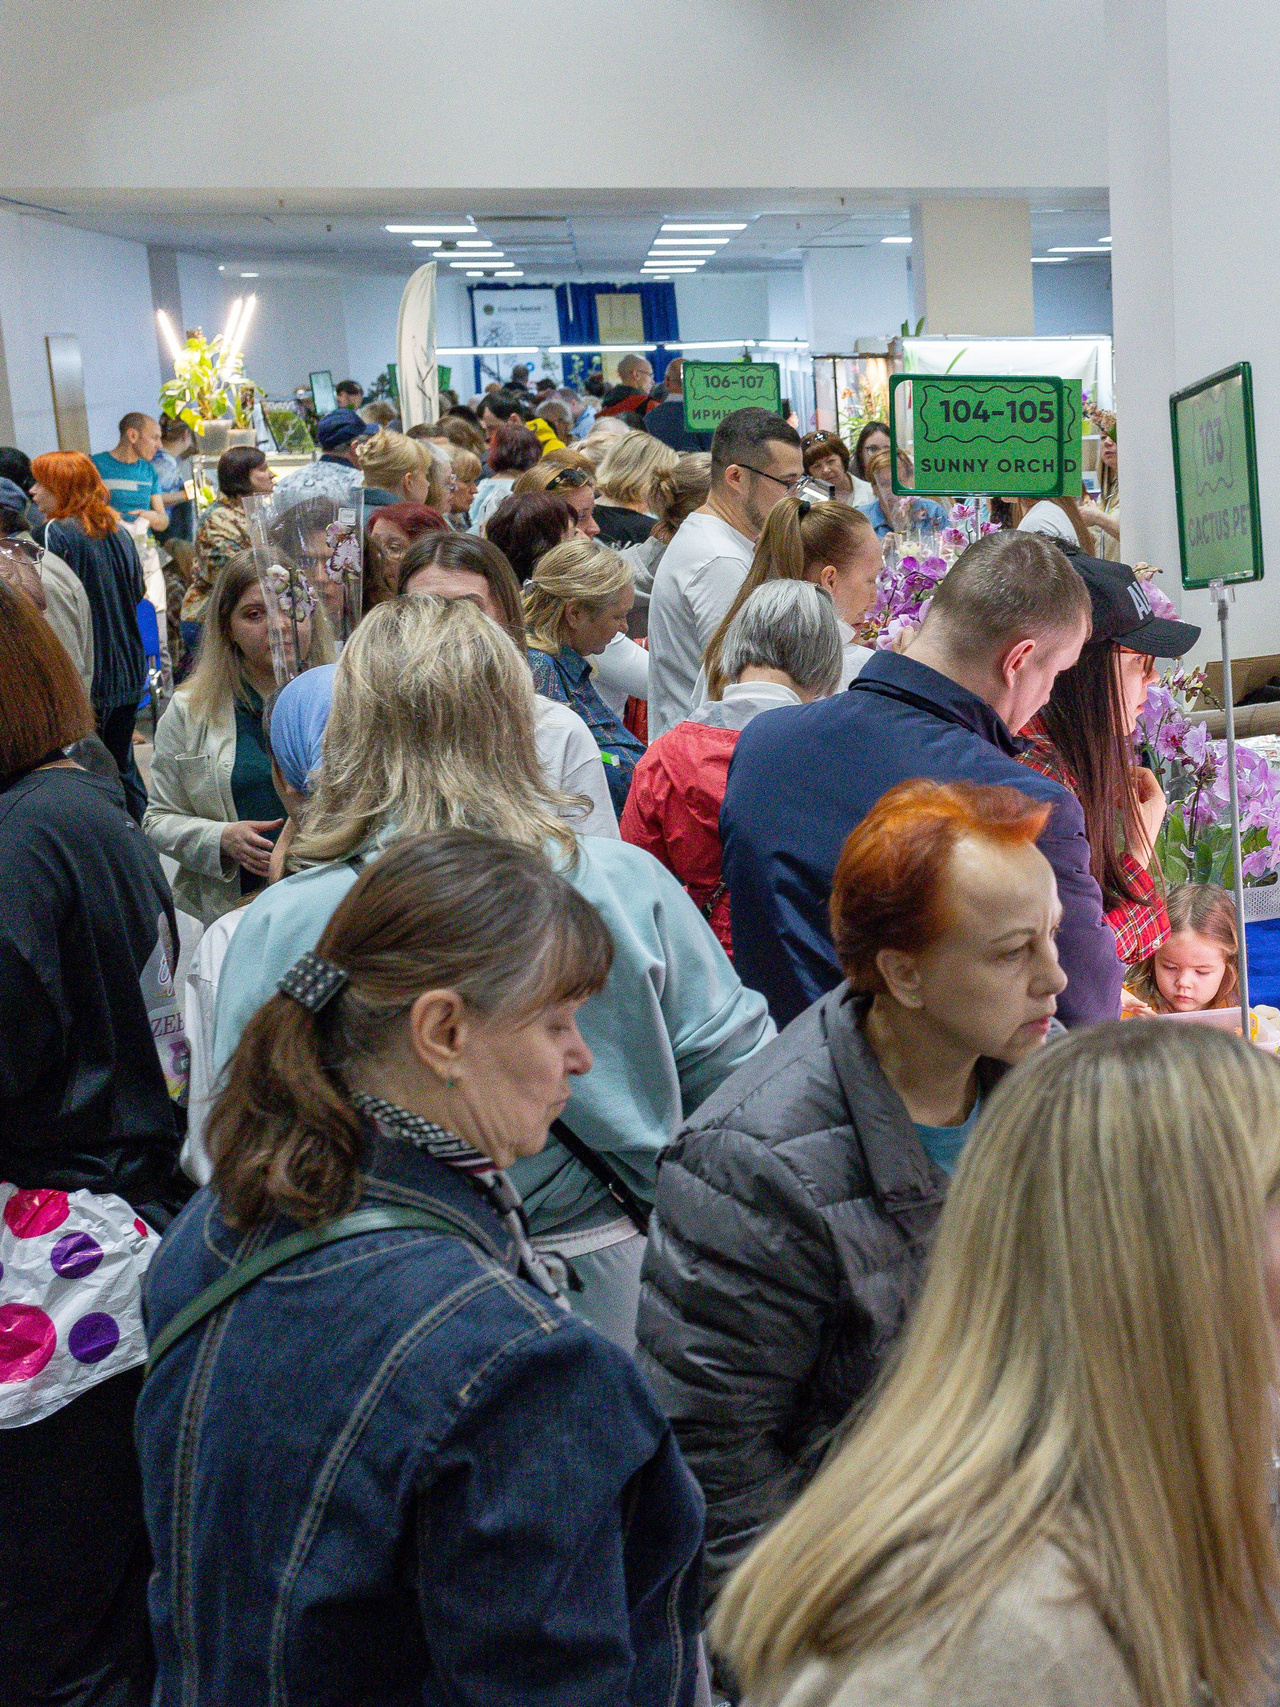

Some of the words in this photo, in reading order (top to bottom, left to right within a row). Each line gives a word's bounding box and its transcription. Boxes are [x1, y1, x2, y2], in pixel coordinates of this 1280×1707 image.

[703, 375, 764, 389] 106-107
[940, 399, 1055, 424] 104-105
[1199, 416, 1224, 467] 103
[921, 458, 989, 474] SUNNY
[997, 458, 1077, 474] ORCHD
[1188, 510, 1230, 548] CACTUS
[1232, 503, 1250, 537] PE
